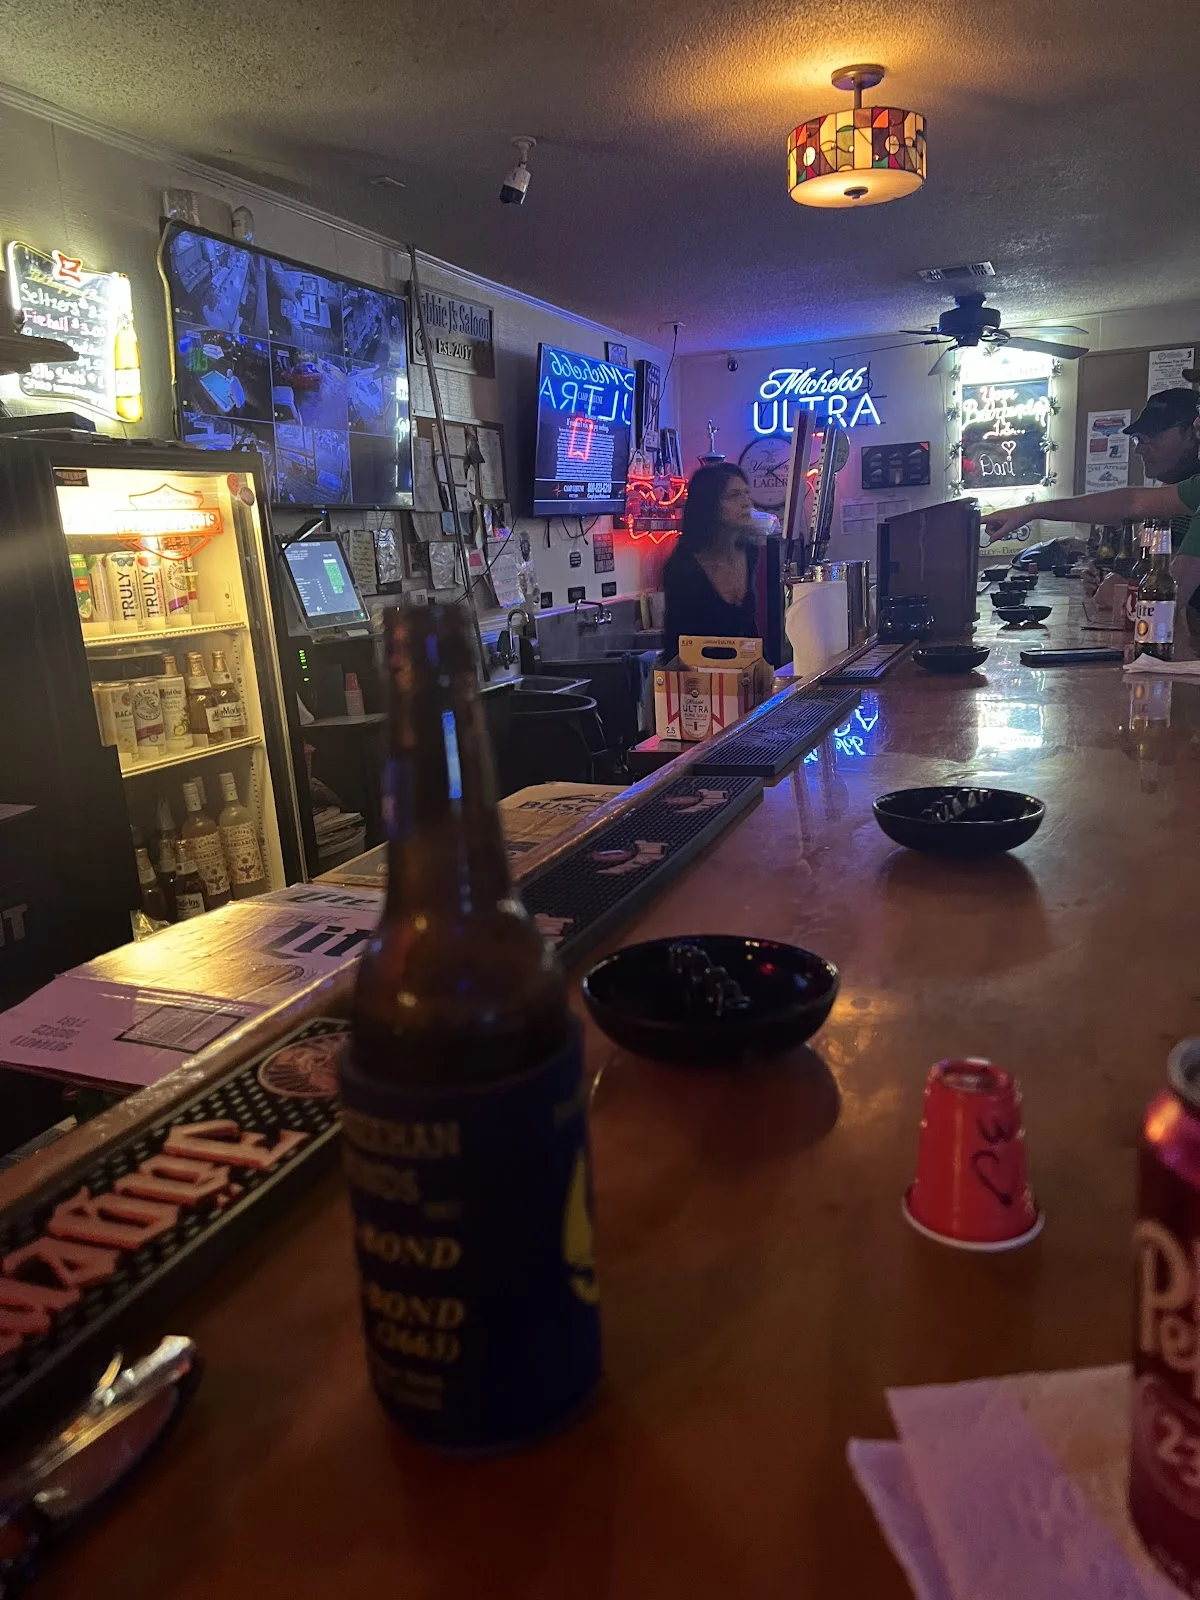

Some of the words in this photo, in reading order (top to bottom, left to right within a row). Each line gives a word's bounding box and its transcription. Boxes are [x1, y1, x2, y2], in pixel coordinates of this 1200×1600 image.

[460, 305, 490, 340] Saloon
[454, 344, 472, 360] 2017
[759, 367, 868, 399] Michelob
[753, 392, 881, 434] ULTRA
[980, 454, 1017, 476] Dani
[117, 571, 136, 620] TRULY
[142, 570, 159, 617] TRULY
[683, 705, 709, 713] ULTRA
[517, 801, 598, 812] BUSC
[261, 920, 376, 959] Lit
[1133, 1219, 1200, 1372] Pe
